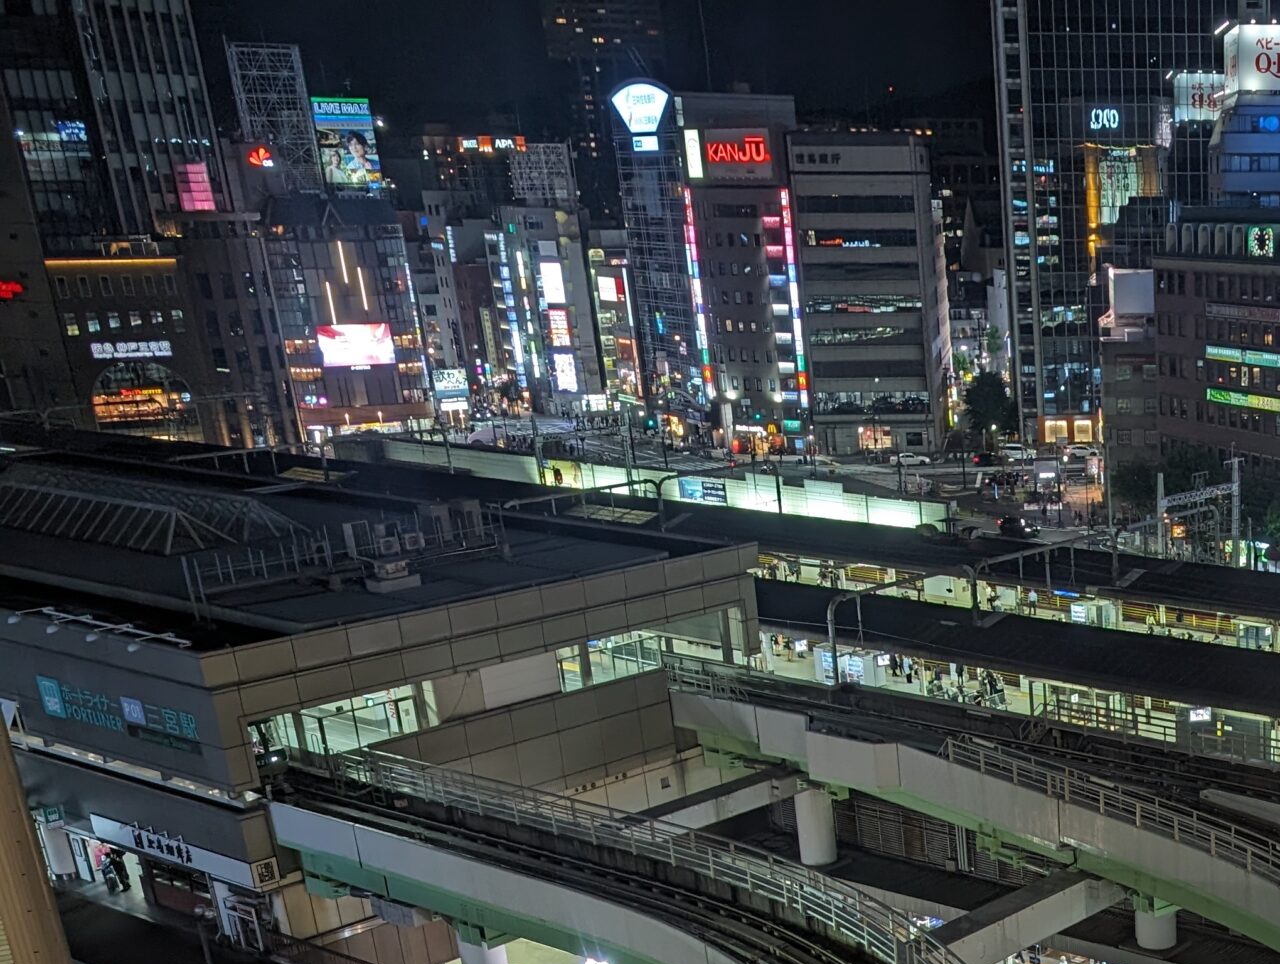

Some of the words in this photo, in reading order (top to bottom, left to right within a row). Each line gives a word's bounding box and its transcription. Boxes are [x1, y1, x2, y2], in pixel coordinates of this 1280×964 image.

[313, 102, 341, 114] LIVE
[342, 103, 369, 115] MAX
[61, 685, 119, 711] ポートライナー
[64, 703, 124, 732] PORTLINER
[144, 704, 200, 740] 三宮駅
